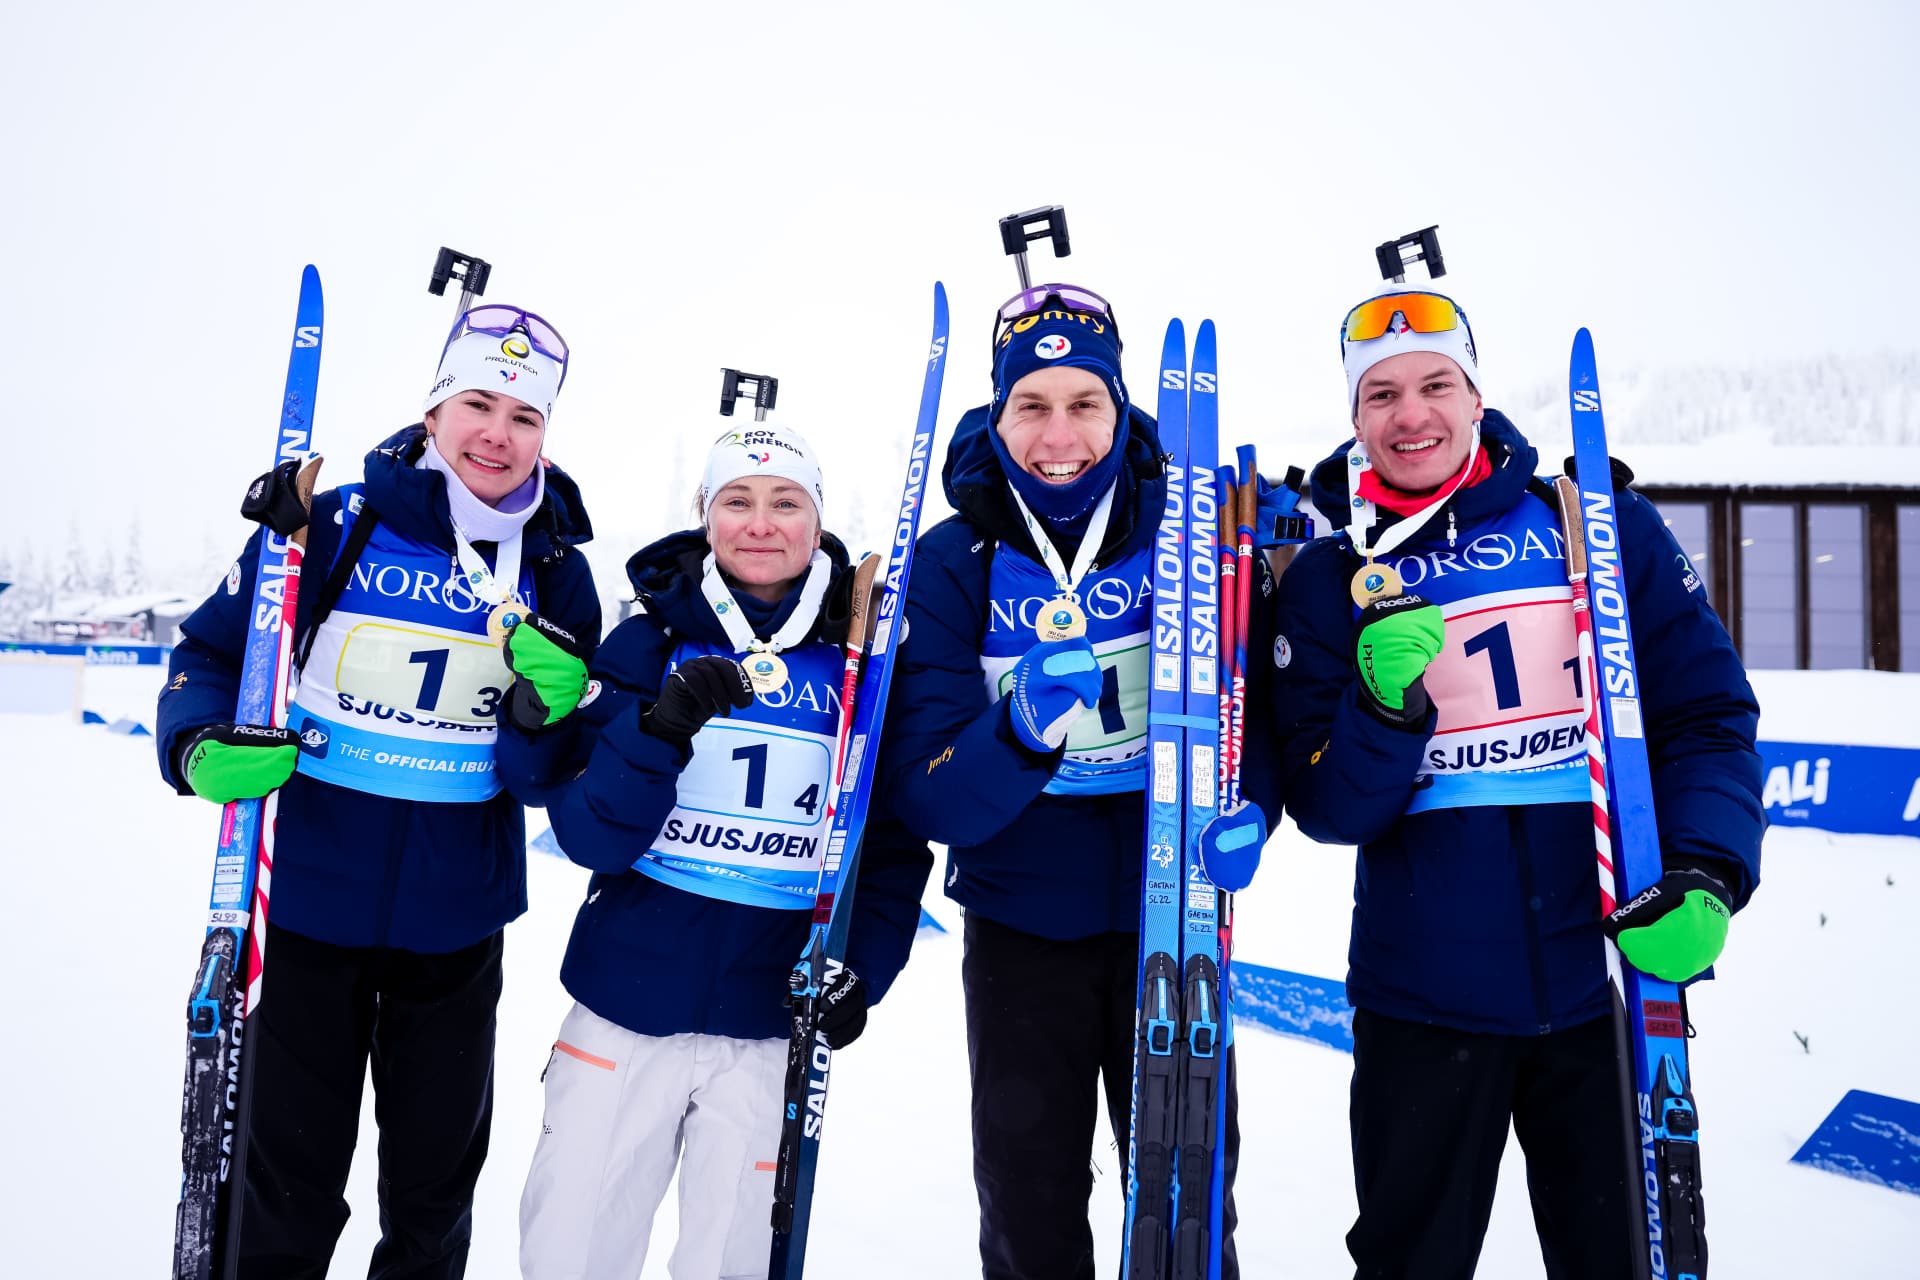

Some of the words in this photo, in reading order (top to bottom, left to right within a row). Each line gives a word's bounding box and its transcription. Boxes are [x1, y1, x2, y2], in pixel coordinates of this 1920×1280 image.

[485, 356, 538, 376] PROLUTECH
[255, 429, 307, 633] SALON
[880, 432, 930, 618] SALOMON
[1155, 464, 1184, 654] SALOMON
[1388, 527, 1567, 587] ORSAN
[346, 562, 532, 614] NORSN
[1191, 465, 1217, 657] SALOMON
[1583, 491, 1637, 698] SALOMON
[989, 574, 1152, 632] NOSA
[85, 647, 139, 665] bama
[408, 648, 450, 712] 1
[471, 686, 502, 718] 3
[1463, 620, 1522, 710] 1
[233, 725, 288, 740] Roeckl
[340, 743, 371, 761] THE
[374, 751, 457, 772] OFFICIAL
[460, 761, 488, 773] IBU
[1219, 694, 1230, 816] ALOMON
[1231, 676, 1245, 808] ALOMON
[1429, 723, 1586, 770] SJUSJØEN
[732, 743, 768, 809] 1
[793, 783, 820, 816] 4
[663, 819, 819, 859] SJUSJØEN
[1148, 880, 1176, 890] GAETAN
[1610, 886, 1662, 923] Roeckl
[803, 957, 843, 1141] SALON
[1637, 1092, 1668, 1280] SALOMO
